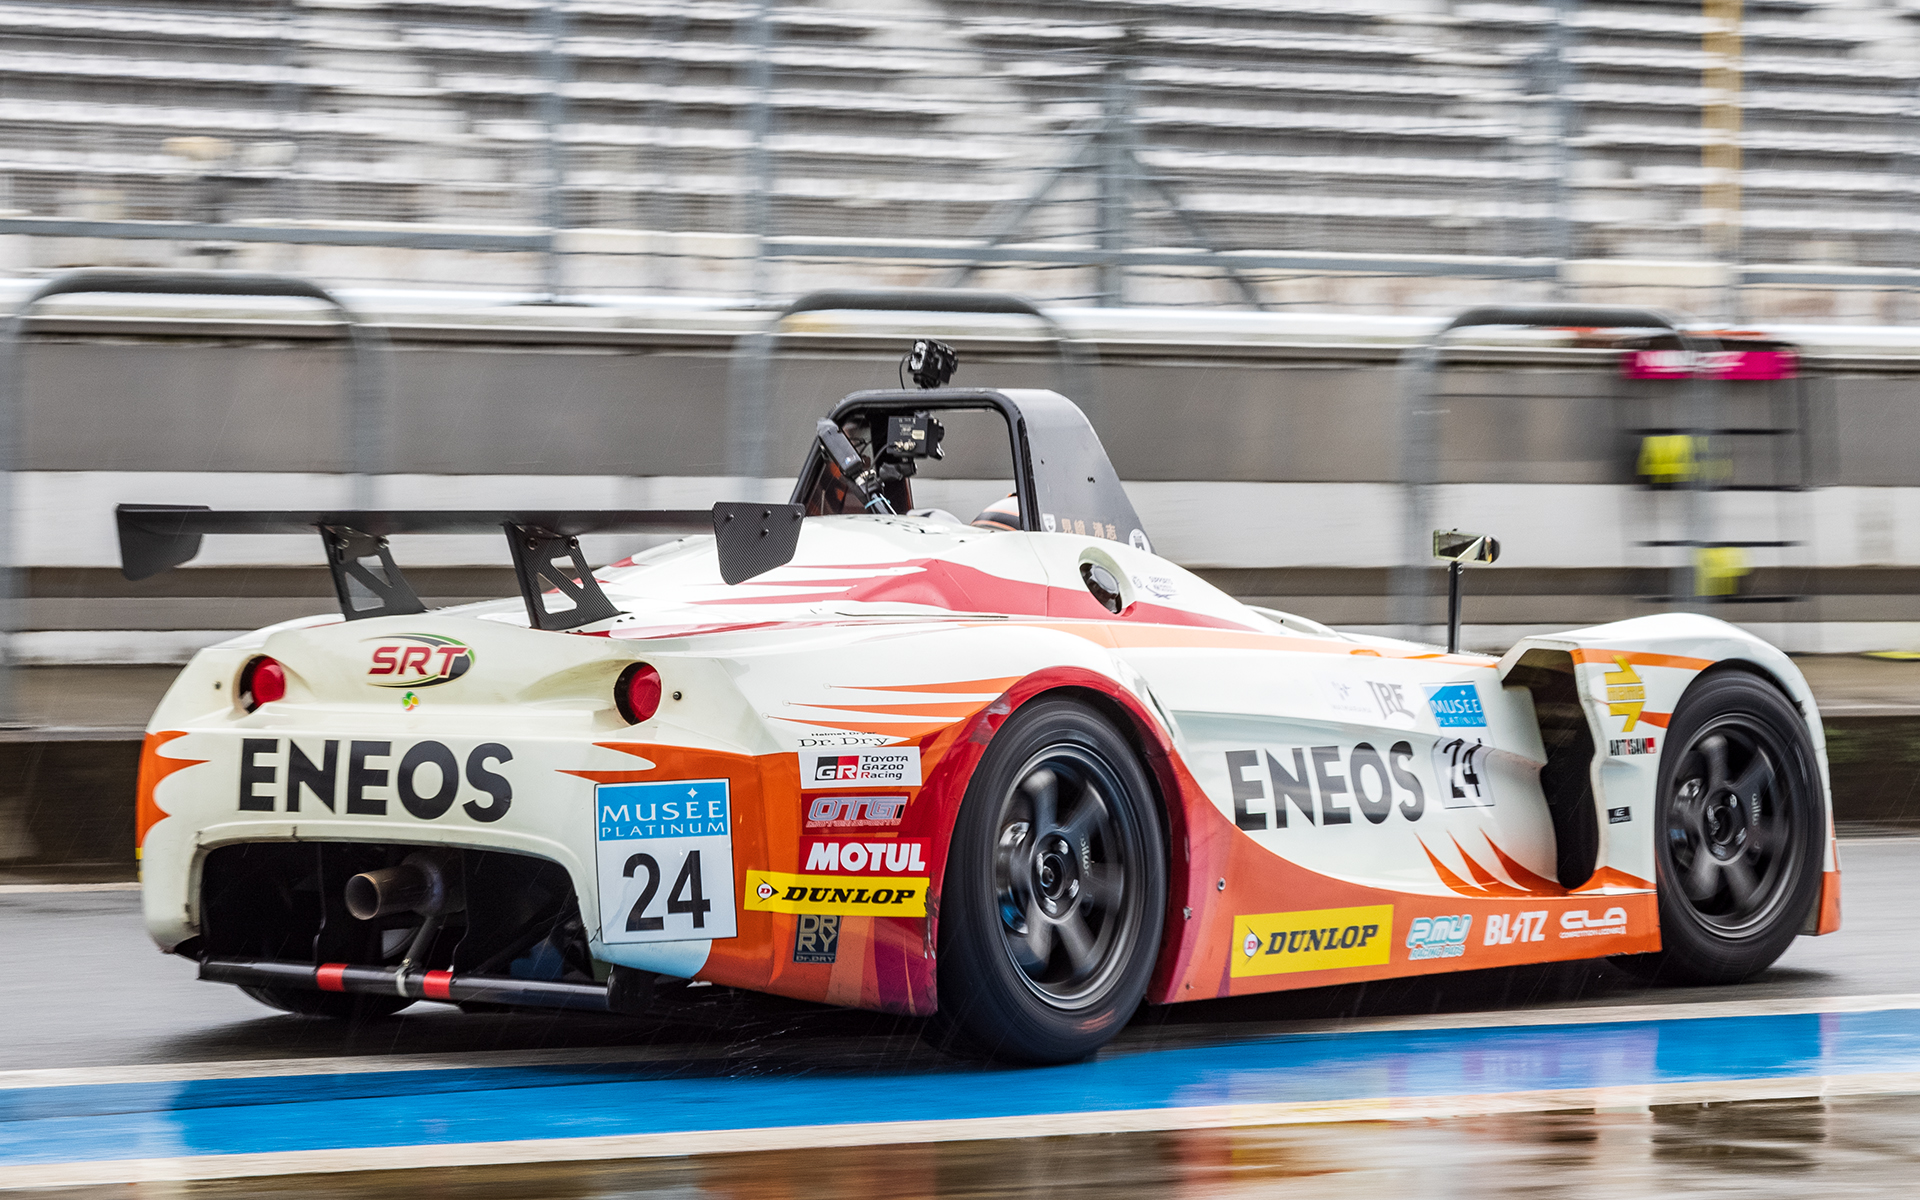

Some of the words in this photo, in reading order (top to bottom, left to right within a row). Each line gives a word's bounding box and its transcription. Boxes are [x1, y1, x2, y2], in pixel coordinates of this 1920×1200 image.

[368, 646, 470, 676] SRT
[797, 738, 835, 748] Dr.
[840, 736, 889, 747] Dry
[861, 763, 905, 771] GAZOO
[862, 755, 909, 763] TOYOTA
[1443, 738, 1482, 799] 24
[238, 738, 513, 823] ENEOS
[816, 764, 858, 780] GR
[860, 772, 903, 781] Racing
[1225, 740, 1425, 832] ENEOS
[601, 821, 726, 838] PLATINUM
[805, 842, 926, 873] MOTUL
[622, 849, 712, 933] 24
[782, 886, 916, 904] DUNLOP
[1265, 924, 1379, 956] DUNLOP
